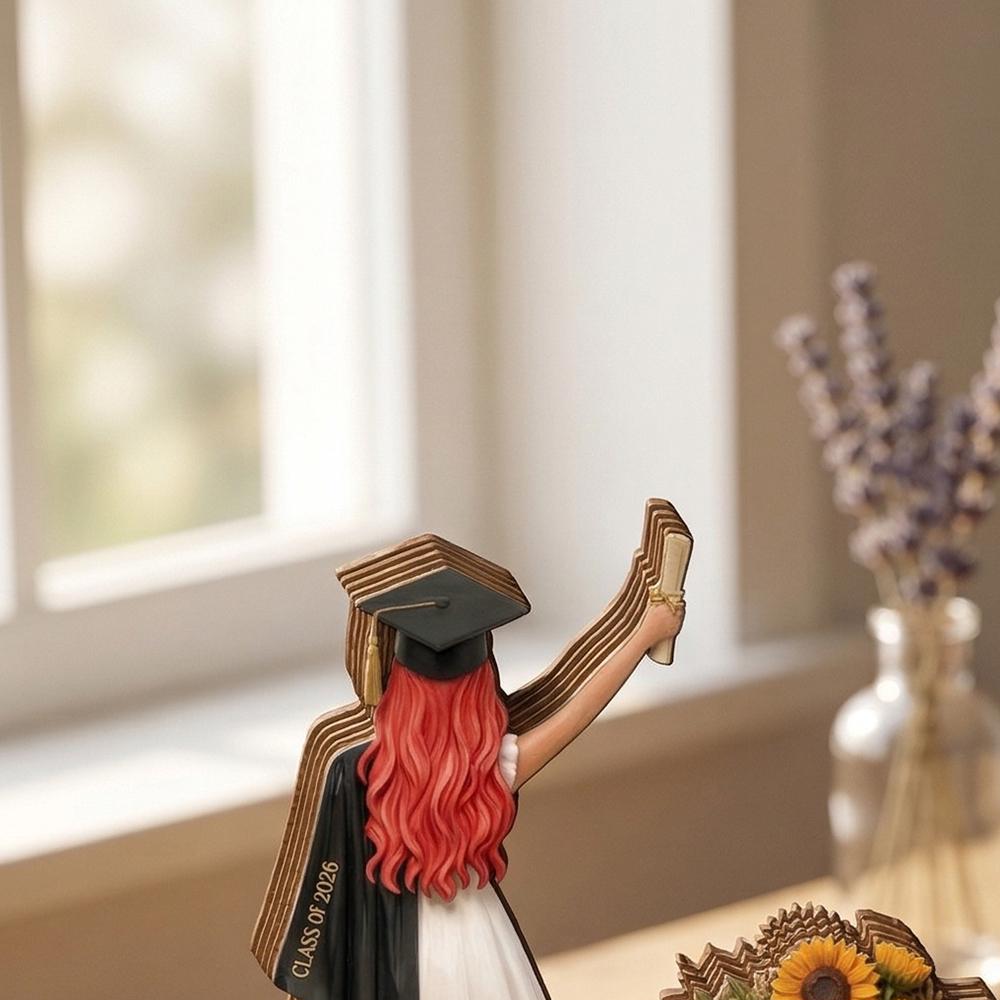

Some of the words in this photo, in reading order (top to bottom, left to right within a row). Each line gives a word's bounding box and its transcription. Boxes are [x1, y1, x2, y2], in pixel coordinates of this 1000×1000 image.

[313, 861, 339, 904] 2026
[307, 904, 326, 924] OF
[291, 926, 321, 979] CLASS
